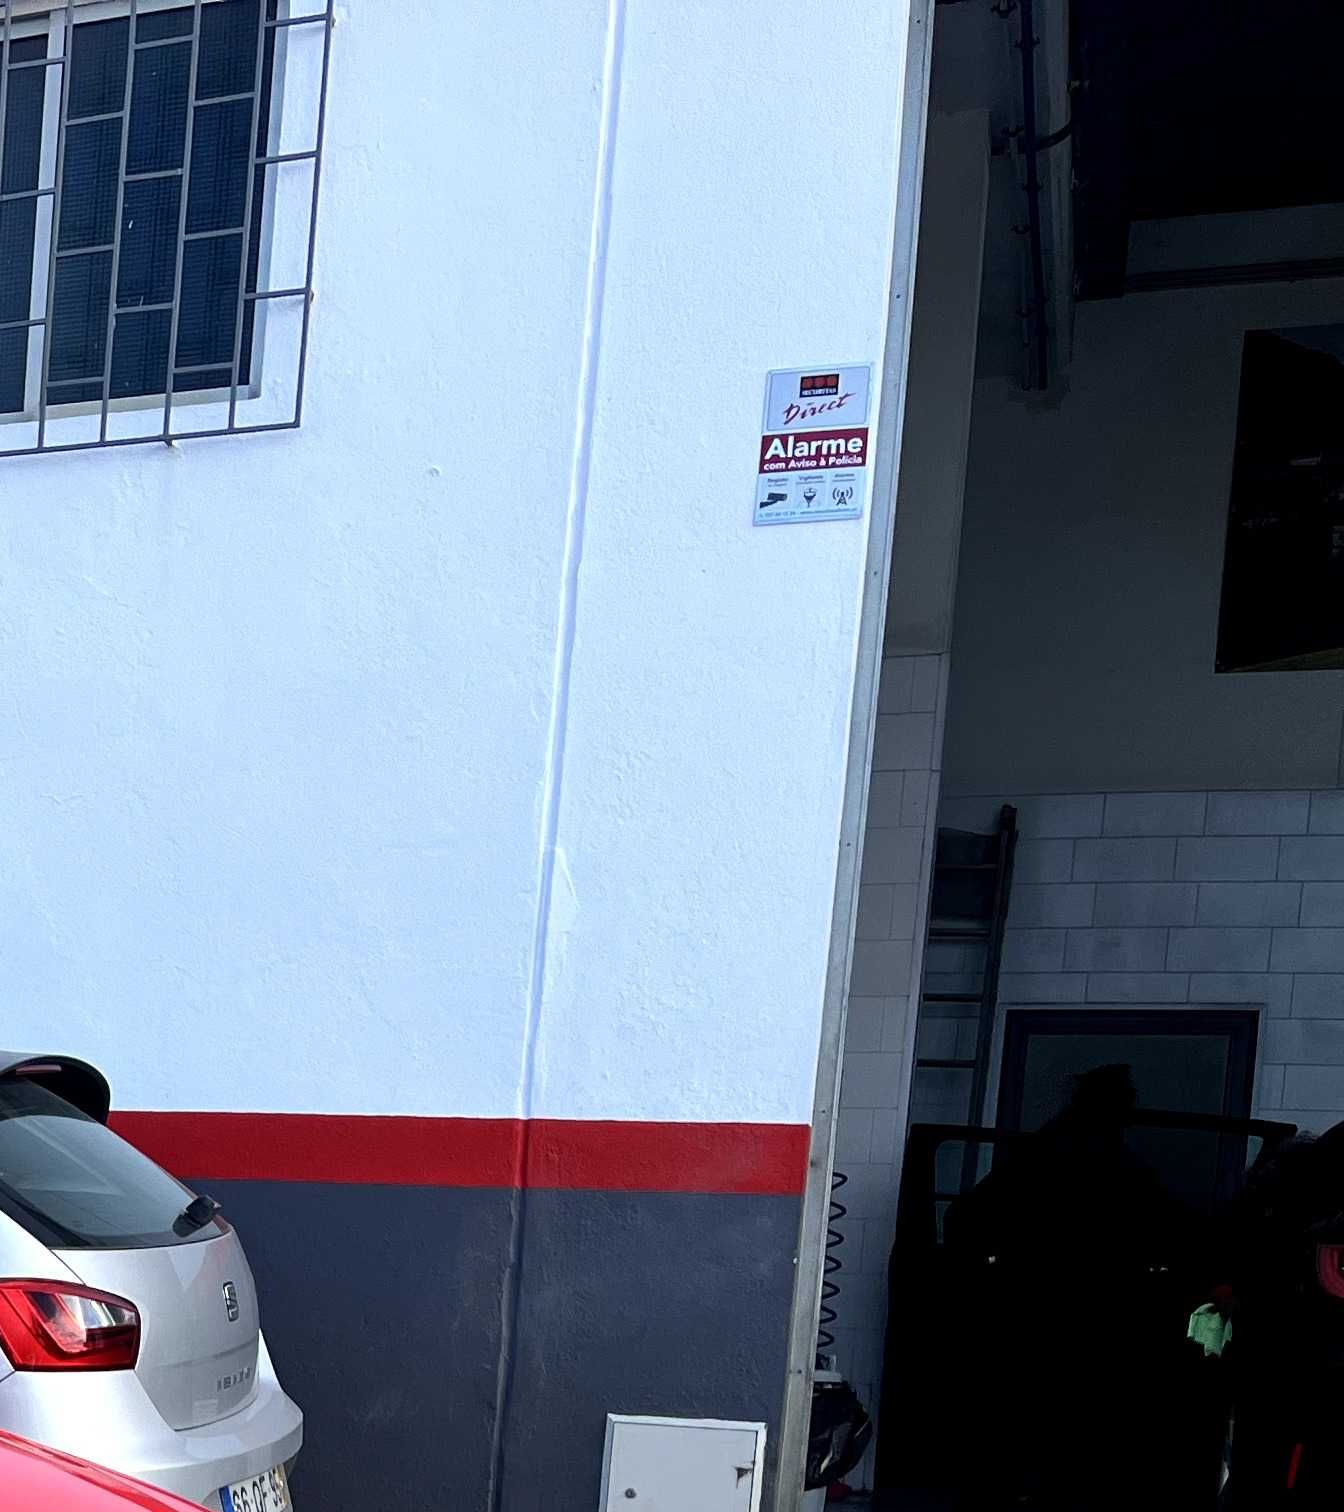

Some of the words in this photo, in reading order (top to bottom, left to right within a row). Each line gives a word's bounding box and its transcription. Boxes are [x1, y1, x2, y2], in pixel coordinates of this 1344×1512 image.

[783, 392, 856, 425] Direct
[764, 436, 863, 460] Alarme
[764, 463, 786, 471] com
[788, 458, 817, 469] Aviso
